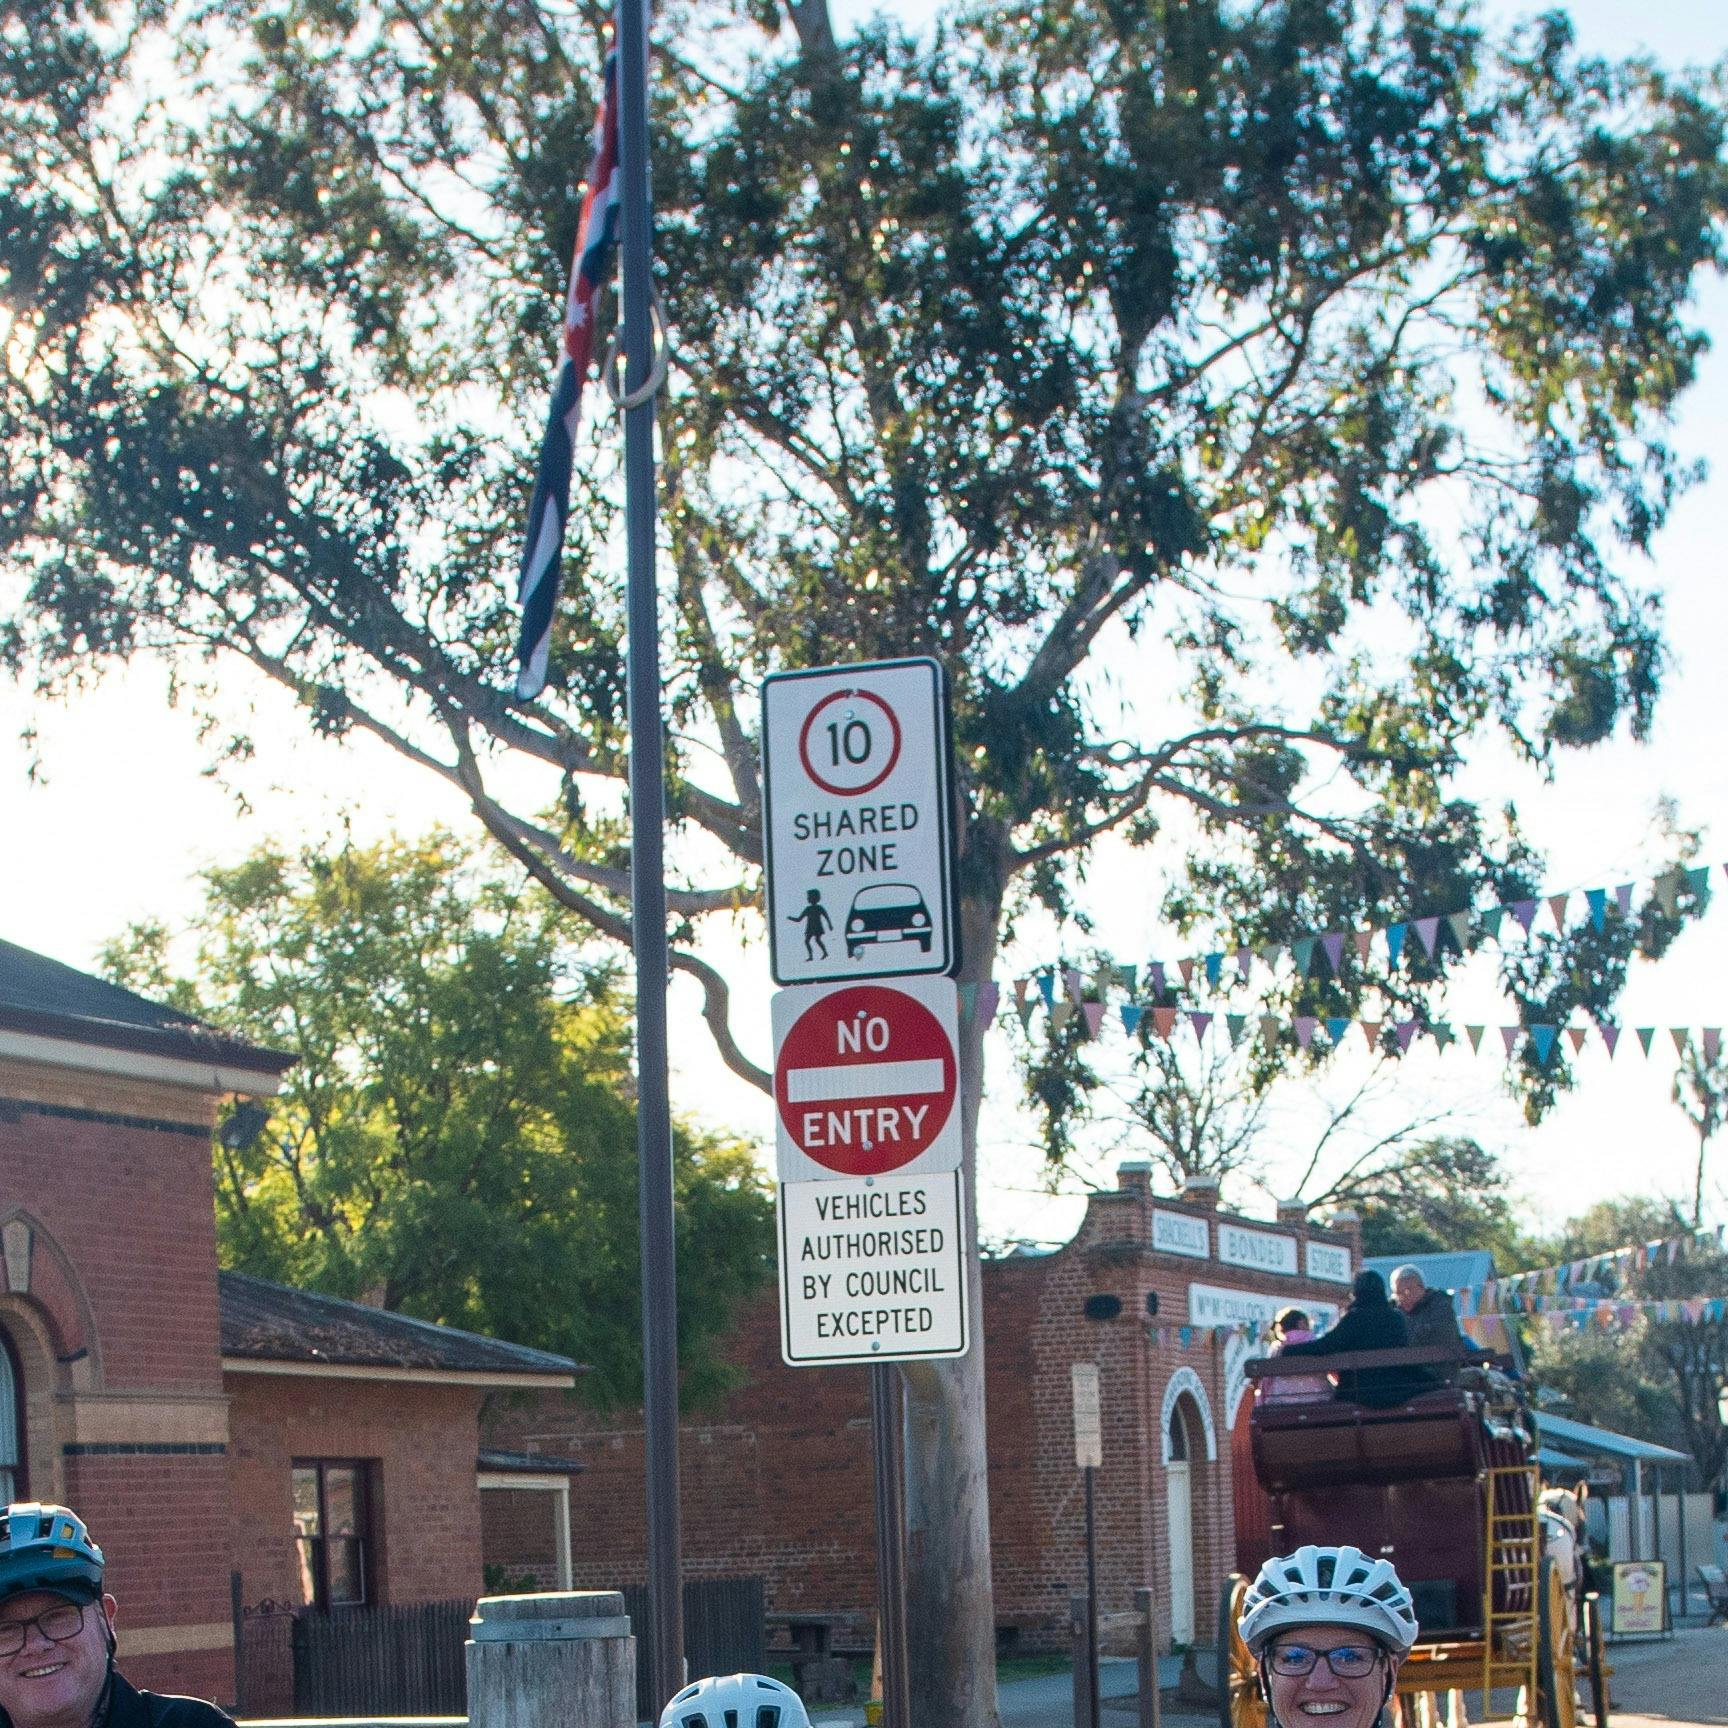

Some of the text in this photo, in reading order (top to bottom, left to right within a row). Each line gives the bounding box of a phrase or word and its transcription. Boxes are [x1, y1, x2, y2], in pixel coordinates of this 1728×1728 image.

[827, 720, 873, 767] 10
[793, 803, 920, 842] SHARED
[816, 843, 899, 878] ZONE
[835, 1017, 890, 1055] NO
[802, 1104, 930, 1149] ENTRY
[815, 1191, 927, 1222] VEHICLES
[801, 1228, 945, 1262] AUTHORISED
[802, 1267, 946, 1302] BY COUNCIL
[816, 1307, 933, 1339] EXCEPTED
